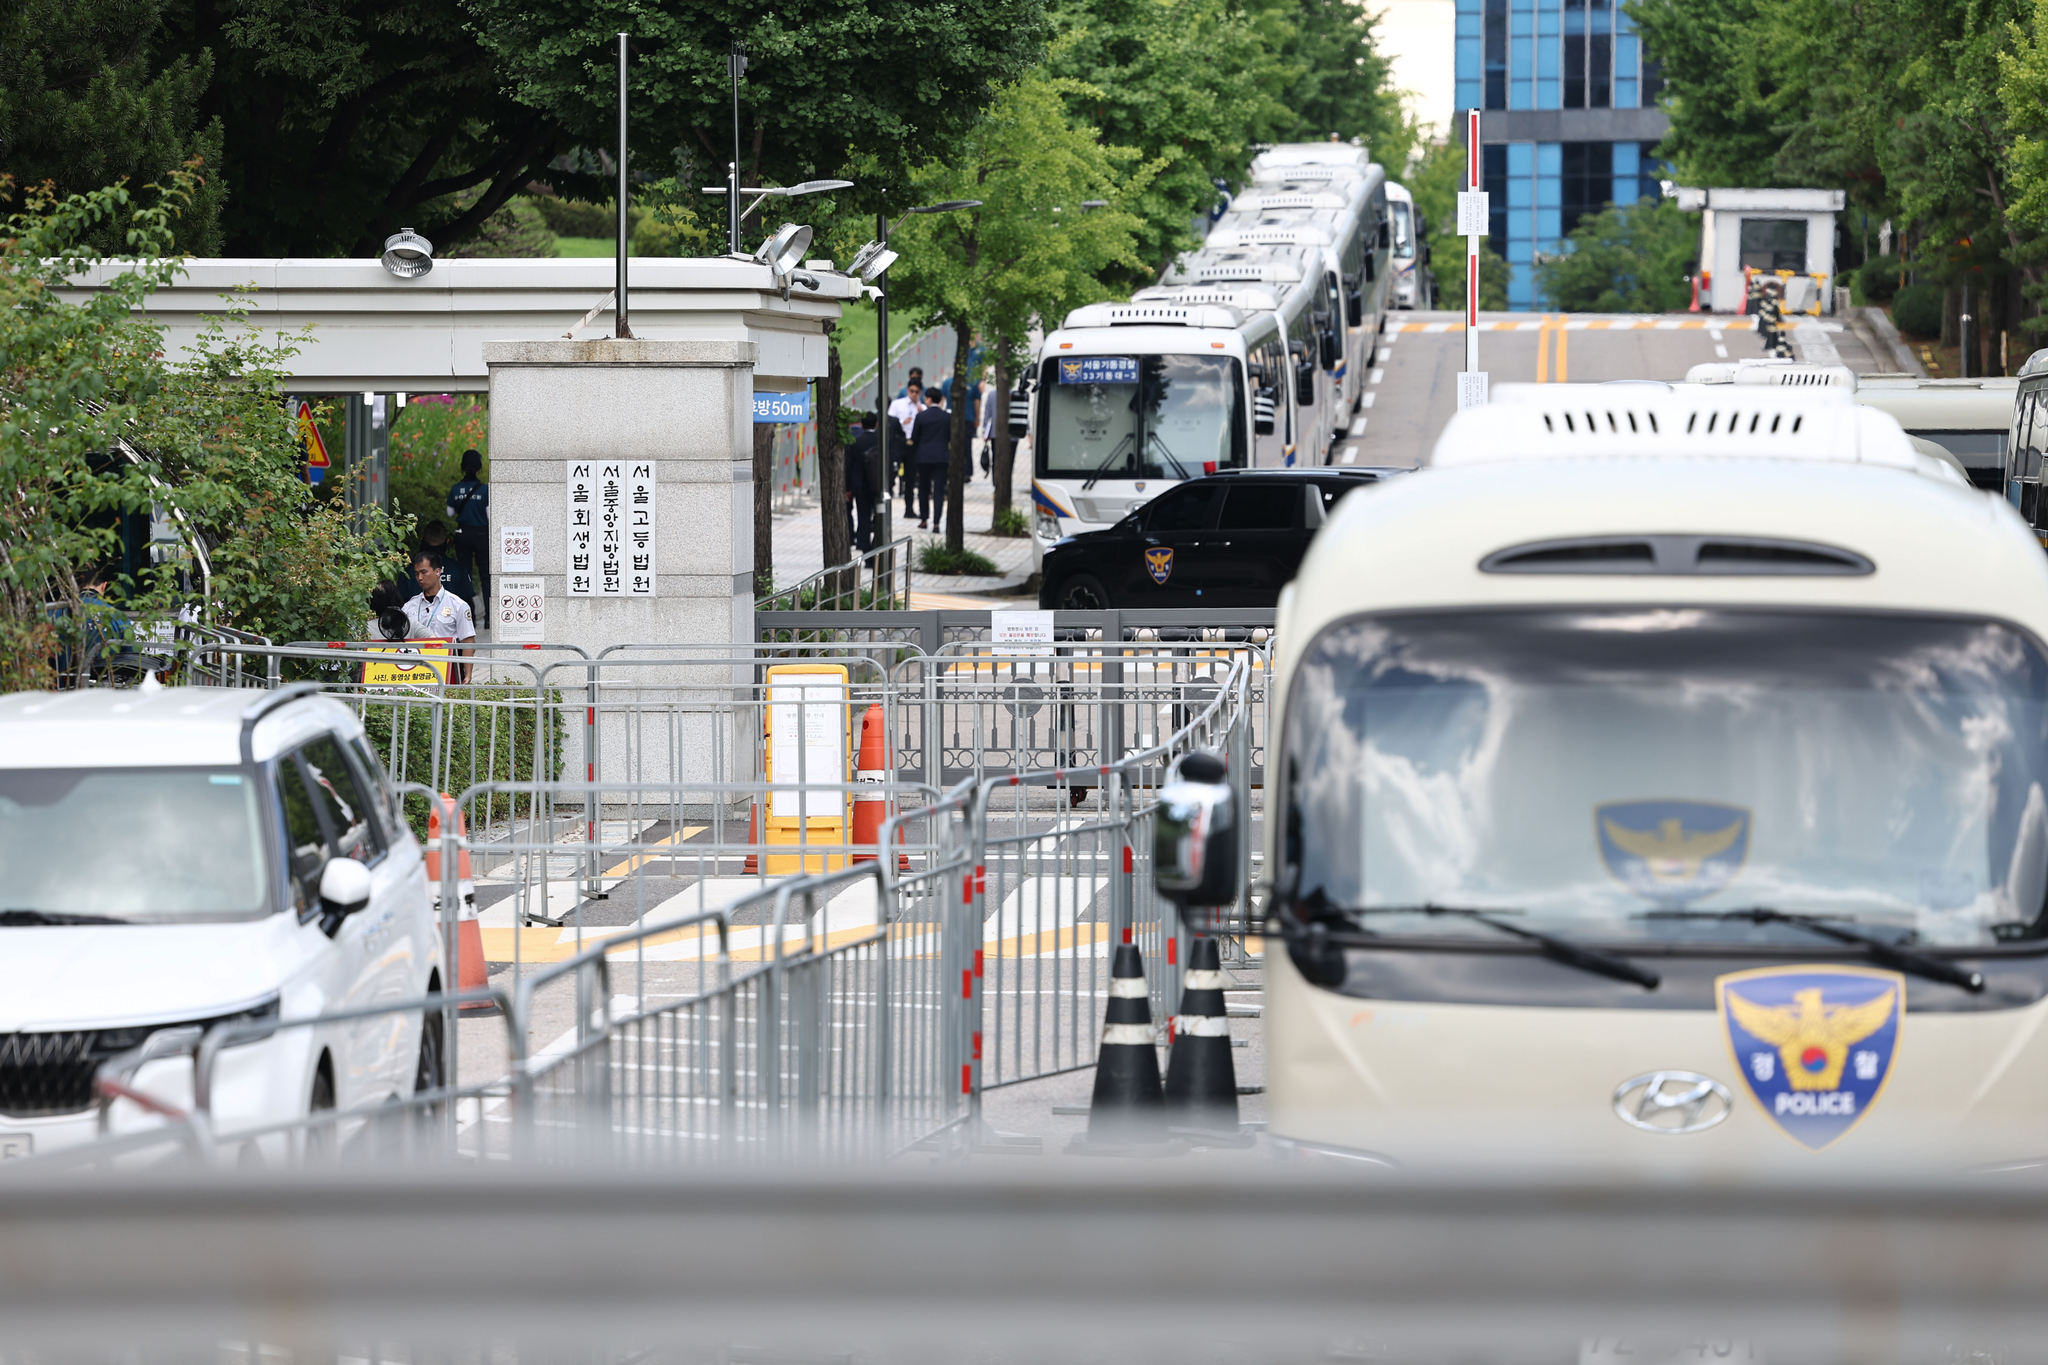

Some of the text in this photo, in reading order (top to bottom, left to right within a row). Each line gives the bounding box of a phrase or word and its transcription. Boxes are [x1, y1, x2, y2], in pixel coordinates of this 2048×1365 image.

[572, 464, 590, 593] 서울회생법원
[603, 464, 620, 593] 서울중앙지방법원
[632, 464, 650, 593] 서울고등법원
[390, 673, 410, 681] 동영상
[1774, 1091, 1856, 1115] POLICE
